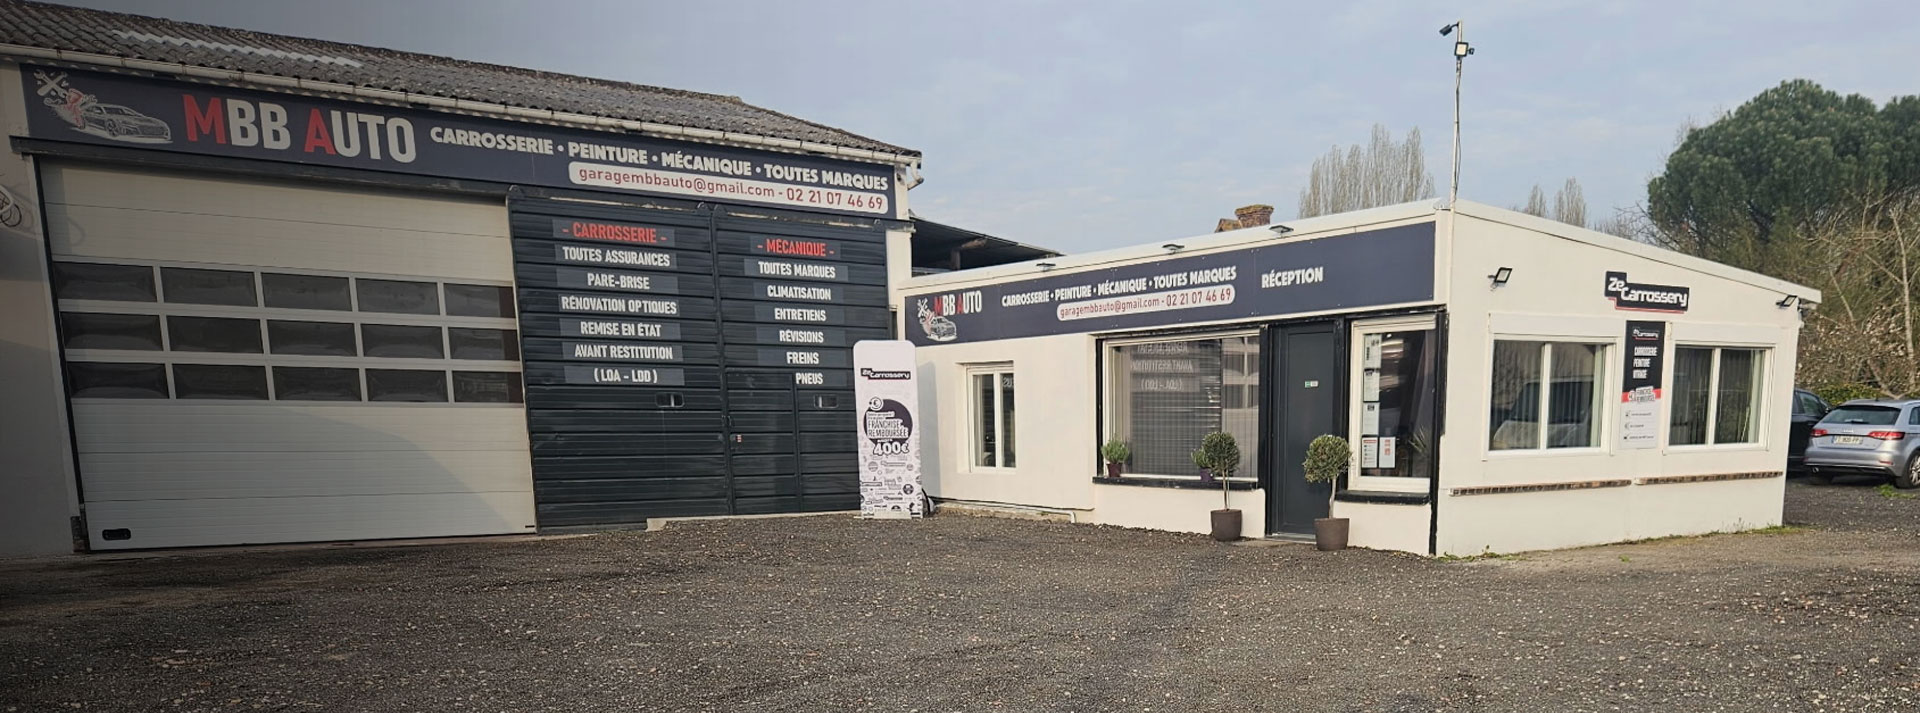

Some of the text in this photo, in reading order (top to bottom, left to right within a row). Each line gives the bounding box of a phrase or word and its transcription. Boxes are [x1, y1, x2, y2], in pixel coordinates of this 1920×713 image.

[182, 94, 416, 163] MBB AUTO
[430, 126, 888, 190] CARROSSERIE PEINTURE MÉCANIQUE TOUTES MARQUES
[579, 167, 775, 198] garagembbauto@gmail.com
[786, 188, 803, 201] 02
[809, 191, 821, 203] 21
[826, 193, 842, 205] 07
[847, 194, 864, 208] 46
[868, 197, 883, 209] 69
[572, 222, 657, 243] CARROSSERIE
[562, 246, 671, 267] TOUTES ASSURANCES
[766, 239, 826, 257] MÉCANIQUE
[758, 261, 836, 278] TOUTES MARQUES
[1261, 266, 1324, 289] RÉCEPTION
[587, 272, 650, 290] PARE-BRISE
[1001, 265, 1237, 307] CARROSSERIE PEINTURE MÉCANIQUE TOUTES MARQUES
[767, 285, 831, 300] CLIMATISATION
[1166, 294, 1177, 307] 02
[1180, 292, 1189, 305] 21
[1191, 290, 1203, 304] 07
[1205, 289, 1217, 303] 46
[1220, 287, 1231, 301] 69
[1608, 276, 1688, 307] Ze Carrossery
[561, 295, 677, 315] RÉNOVATION OPTIQUES
[934, 290, 982, 316] MBB AUTO
[774, 308, 827, 321] ENTRETIENS
[580, 321, 662, 338] REMISE EN ÉTAT
[779, 329, 824, 343] RÉVISIONS
[574, 344, 673, 360] AVANT RESTITUTION
[786, 352, 819, 364] FREINS
[795, 373, 823, 385] PNEUS
[867, 420, 901, 429] FRANCHISE
[873, 441, 909, 456] 400€
